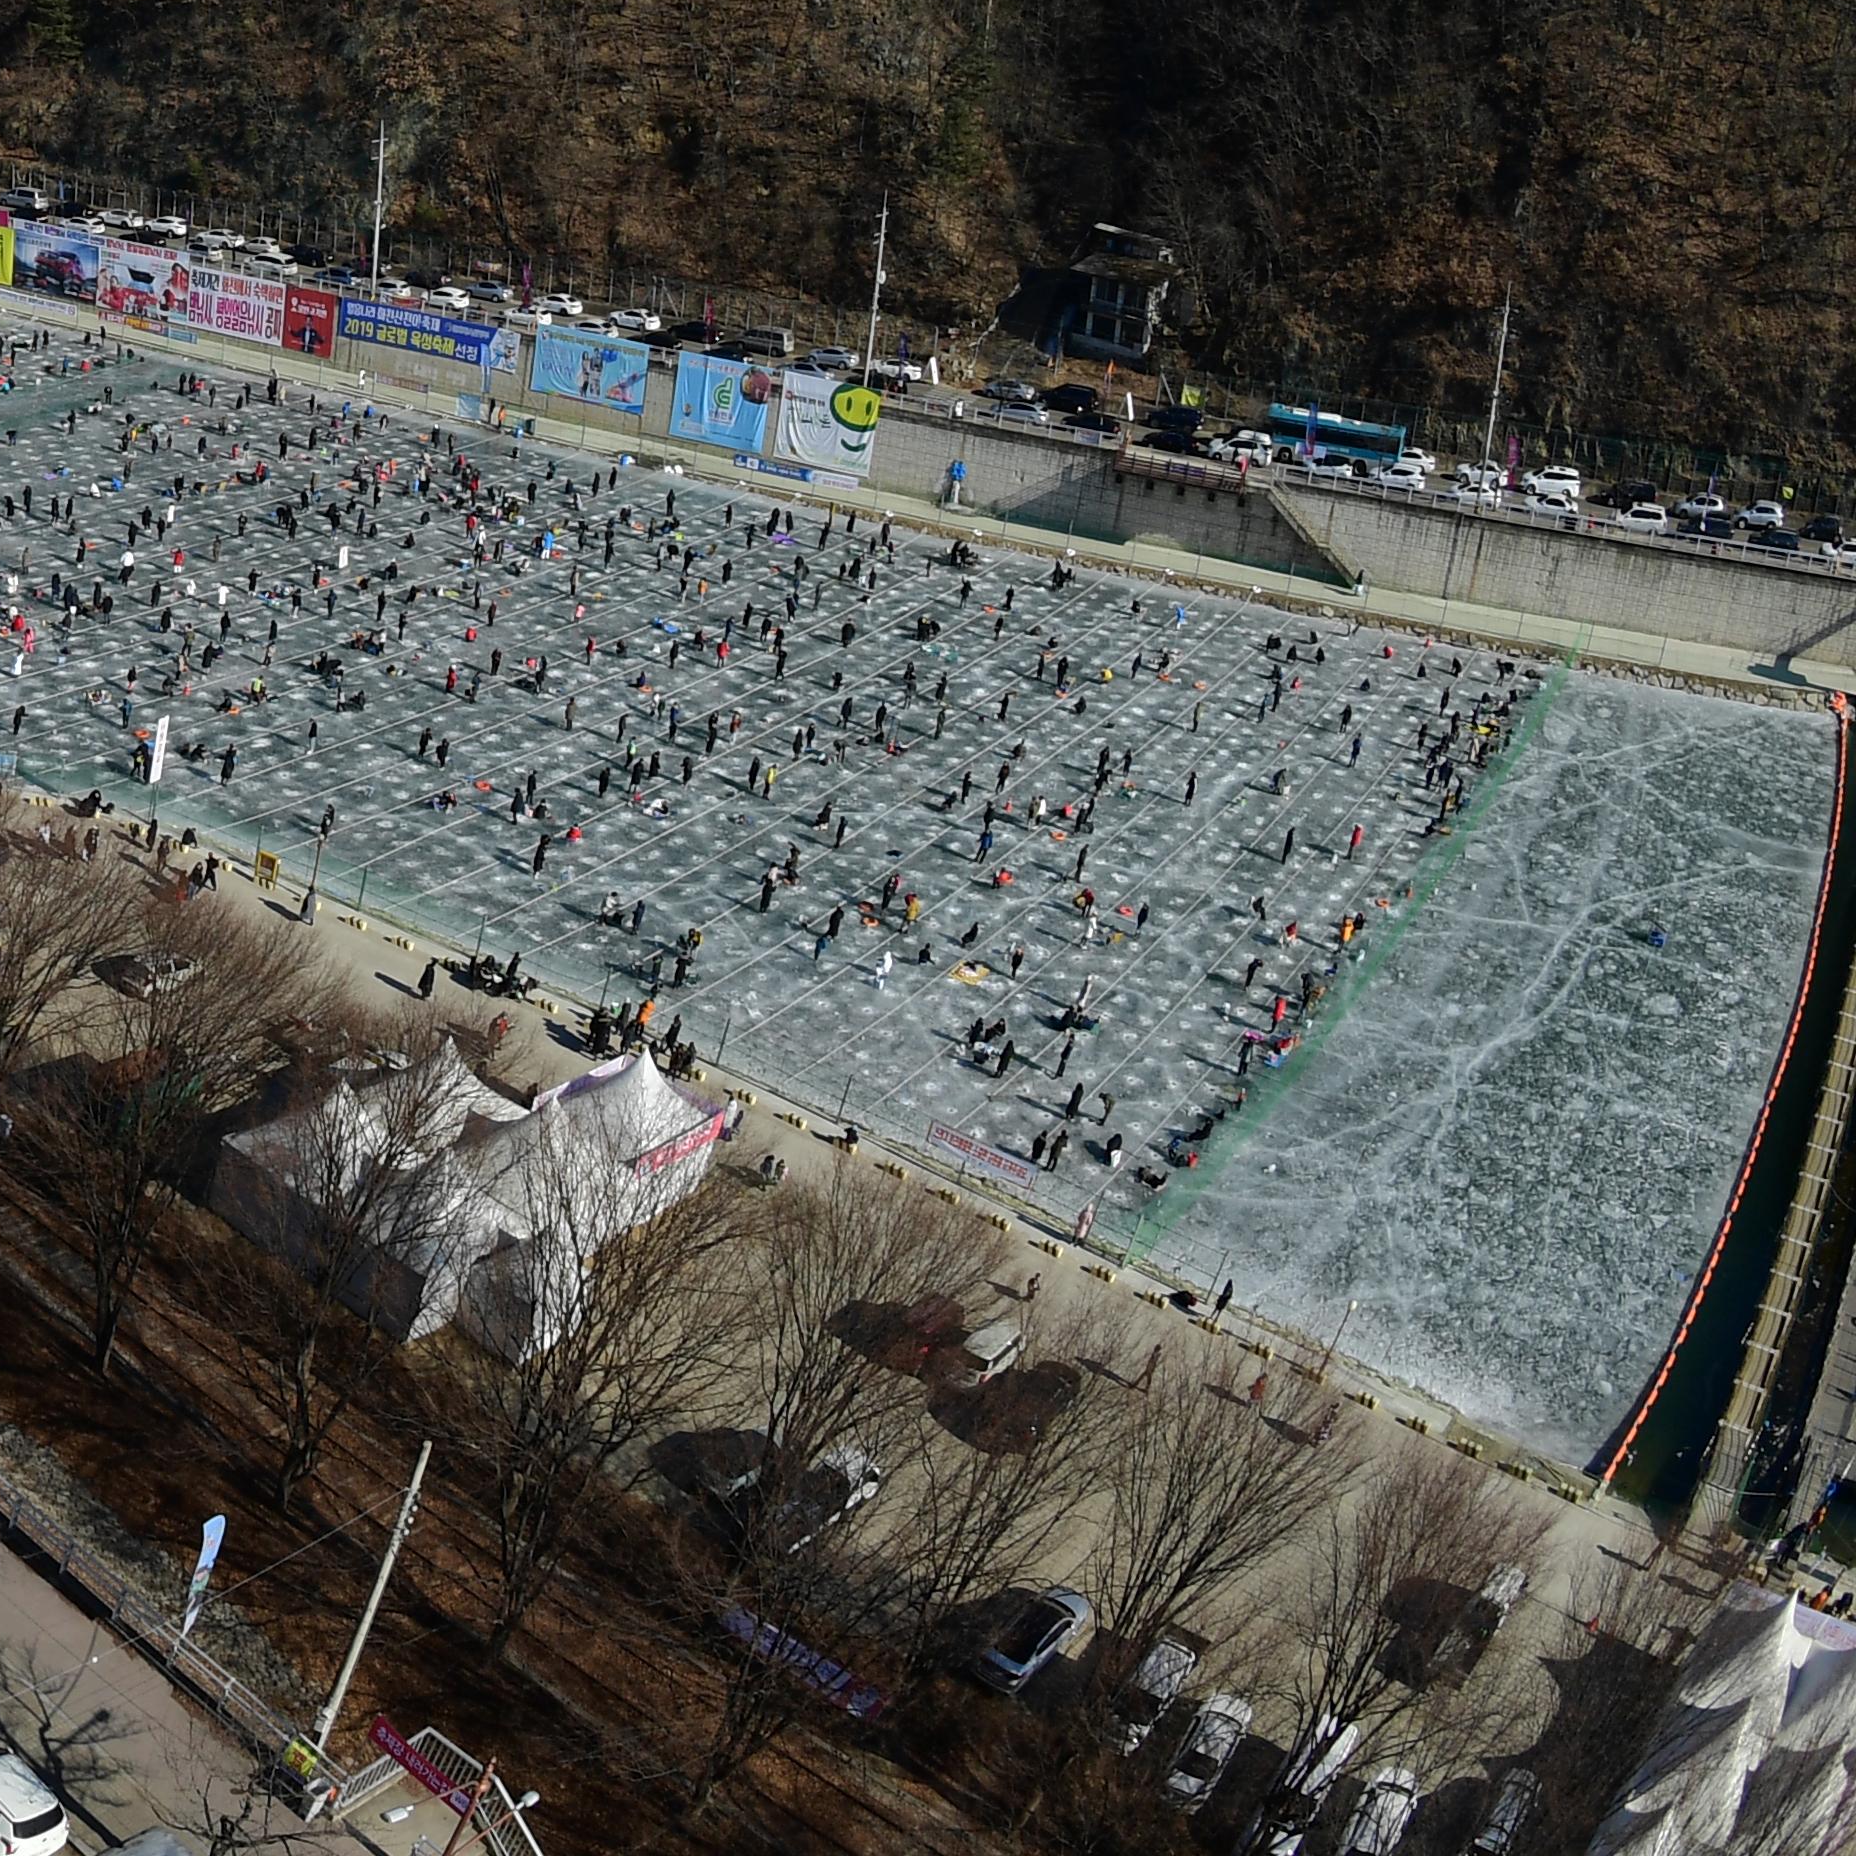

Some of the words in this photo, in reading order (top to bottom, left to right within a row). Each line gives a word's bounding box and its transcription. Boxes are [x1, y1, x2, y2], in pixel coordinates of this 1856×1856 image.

[191, 269, 220, 293] 축제기간
[222, 275, 251, 298] 화천에서
[253, 284, 283, 305] 숙박하면
[265, 306, 282, 341] 공짜
[346, 302, 376, 319] 얼음나라
[344, 317, 374, 338] 2019
[376, 324, 408, 346] 글로벌
[376, 1726, 405, 1757] 축제장
